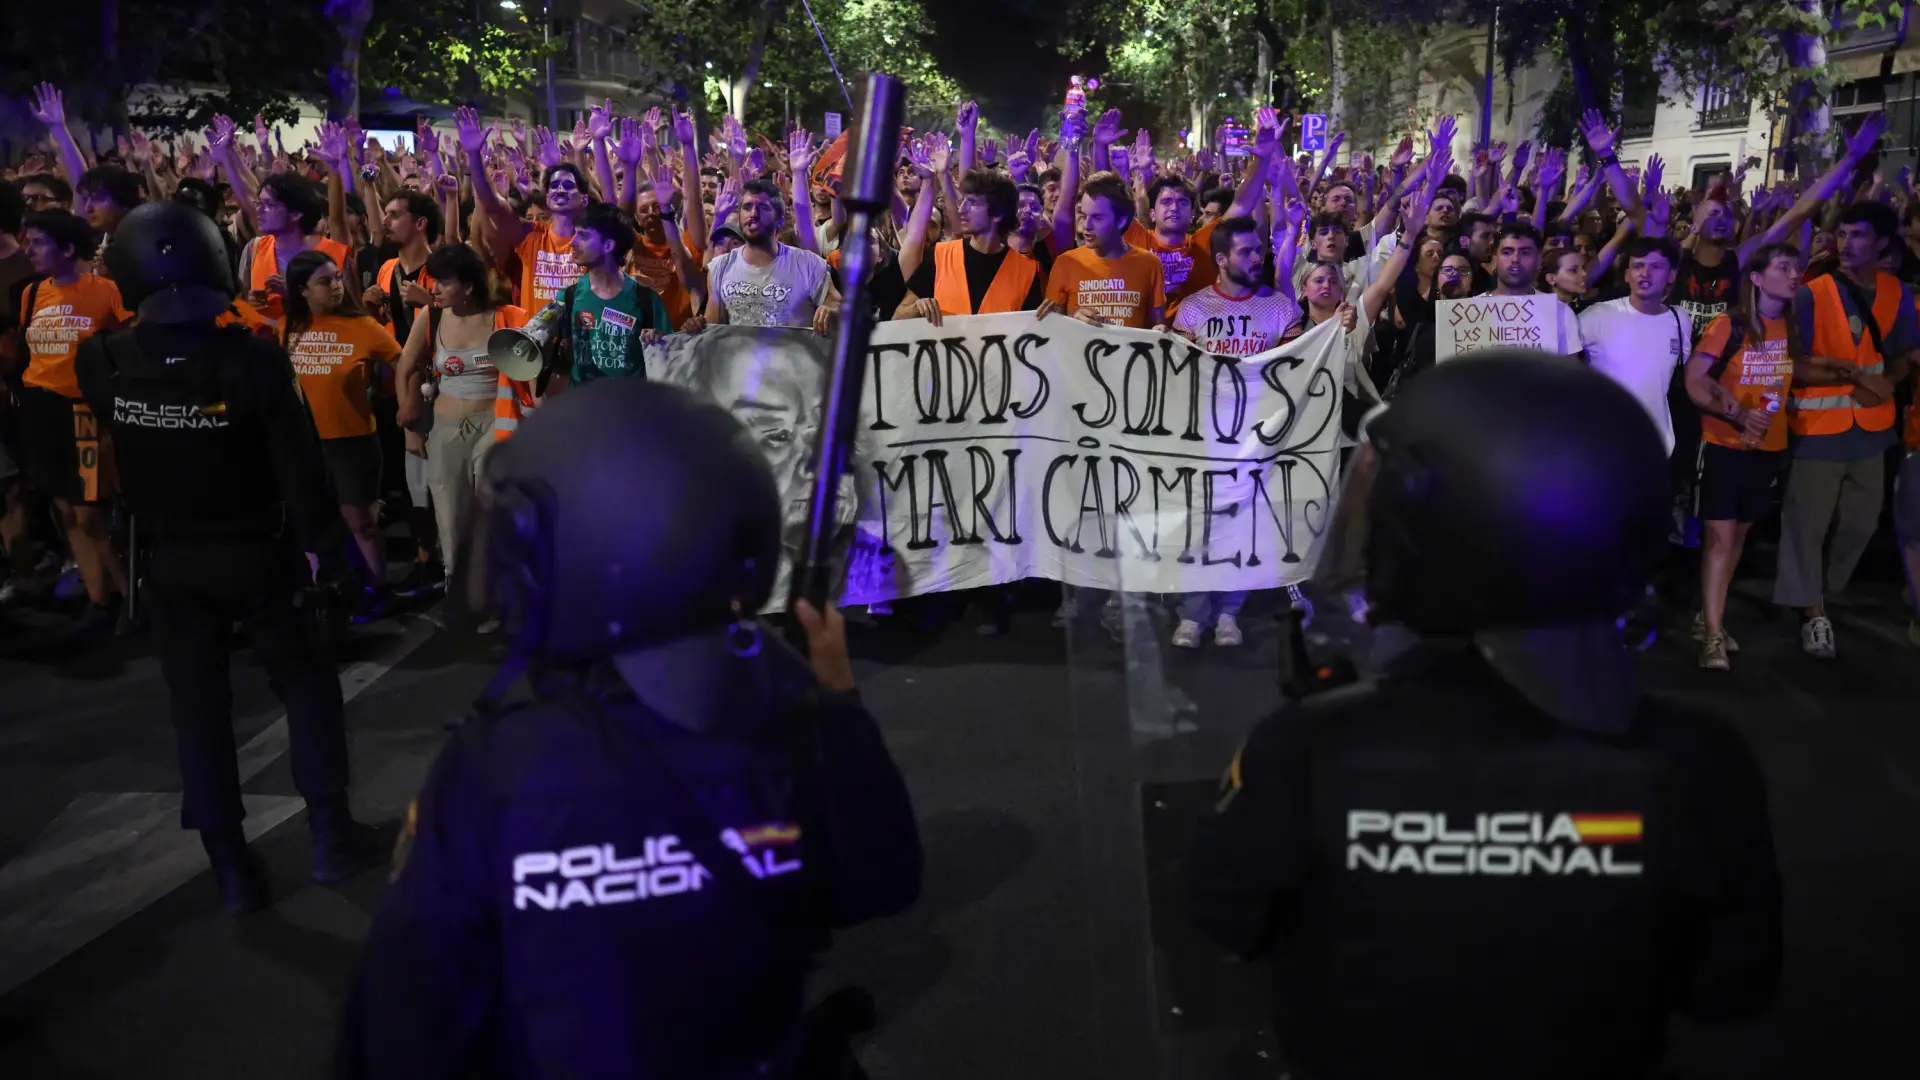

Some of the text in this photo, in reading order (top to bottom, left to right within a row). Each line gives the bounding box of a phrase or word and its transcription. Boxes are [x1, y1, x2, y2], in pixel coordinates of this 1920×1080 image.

[1307, 116, 1322, 138] P
[1079, 279, 1125, 291] SINDICATO
[1080, 292, 1139, 305] DE INQUILINAS
[1449, 299, 1535, 327] SOMOS
[1207, 315, 1252, 338] MST
[1454, 326, 1541, 343] LXS NIETXS
[289, 354, 343, 365] NQUILINOS
[868, 333, 1304, 446] TODOS SOMOS
[114, 396, 203, 417] POLICIA
[113, 409, 229, 428] NACIONAL
[871, 446, 1303, 568] MARI CARMEN
[1347, 811, 1582, 843] POLICIA
[513, 829, 748, 883] POLIC
[1347, 844, 1643, 875] NACIONAL
